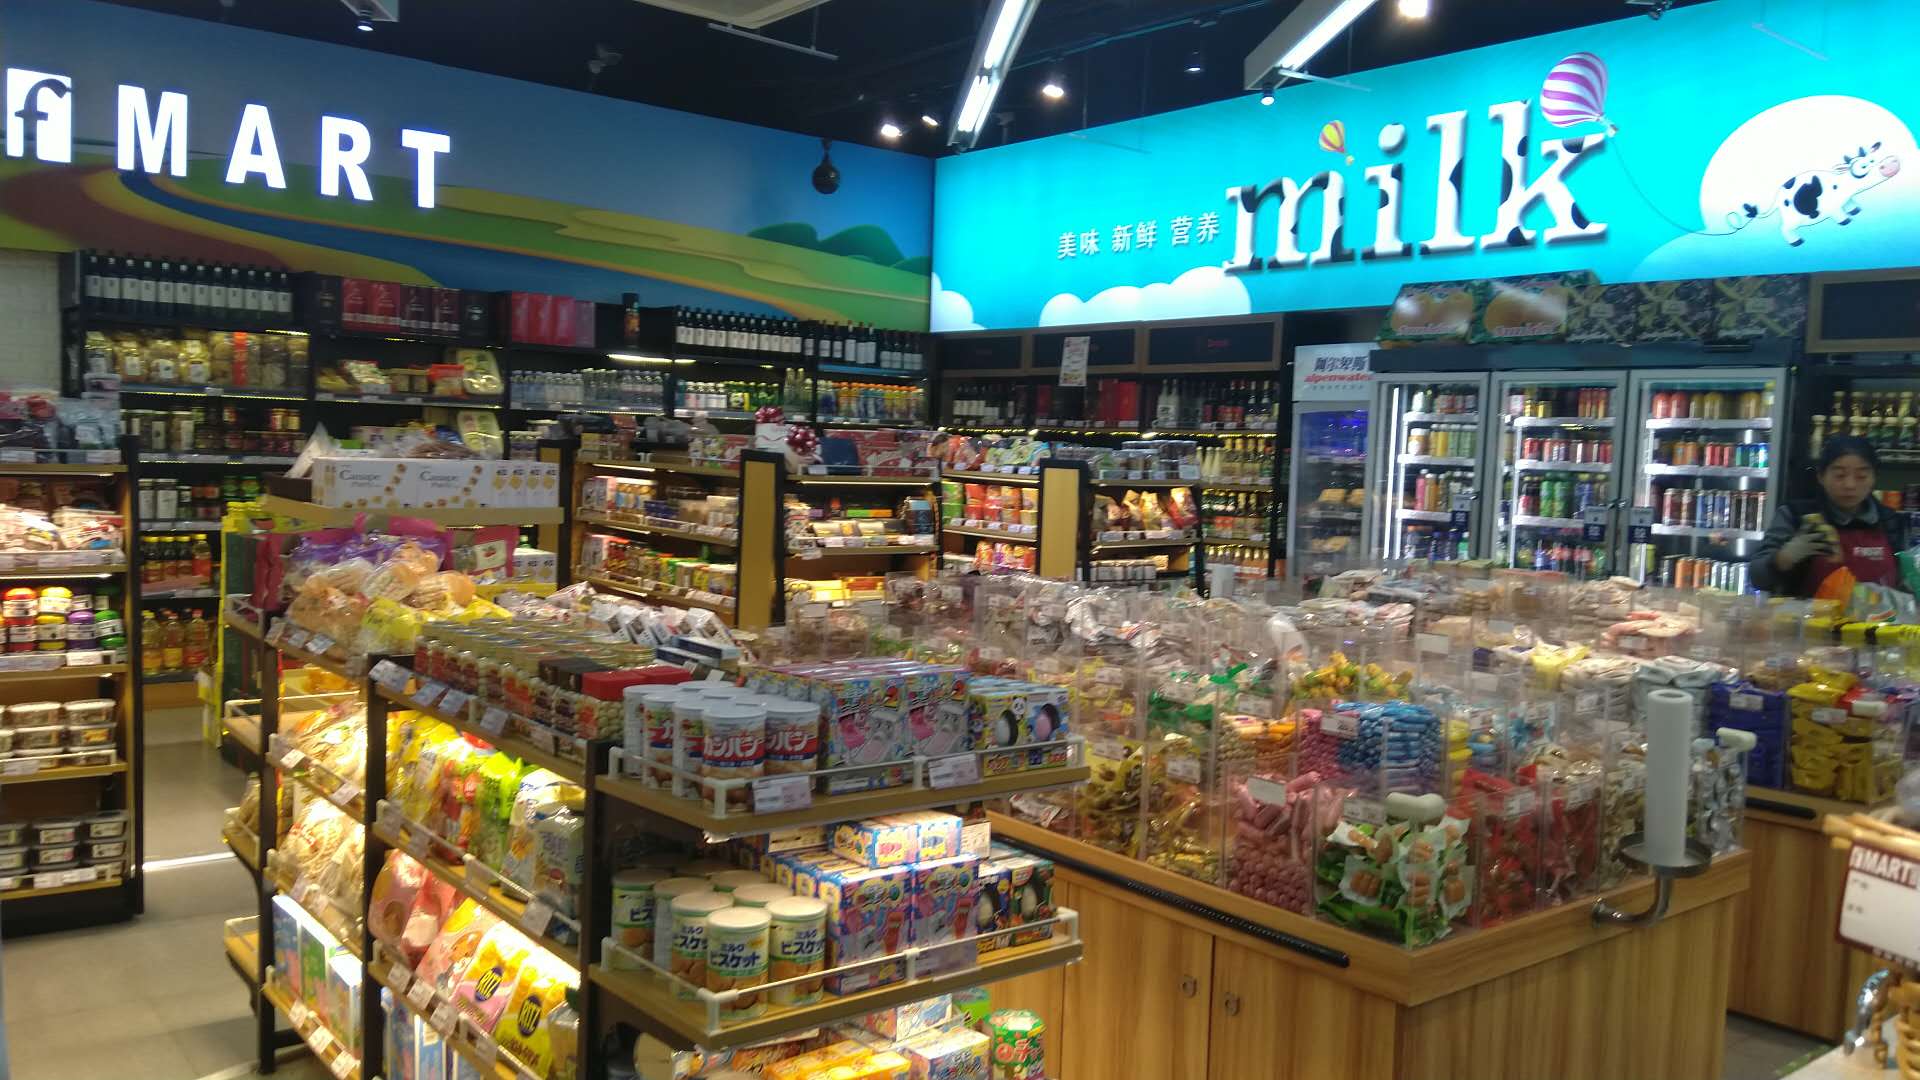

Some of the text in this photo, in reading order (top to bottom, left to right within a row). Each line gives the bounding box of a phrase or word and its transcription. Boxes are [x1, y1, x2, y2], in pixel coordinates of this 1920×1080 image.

[117, 84, 451, 208] MART
[1223, 98, 1609, 274] milk
[1057, 211, 1220, 260] 美味 新鲜 营养
[475, 968, 503, 998] RITZ
[519, 998, 541, 1032] RITZ
